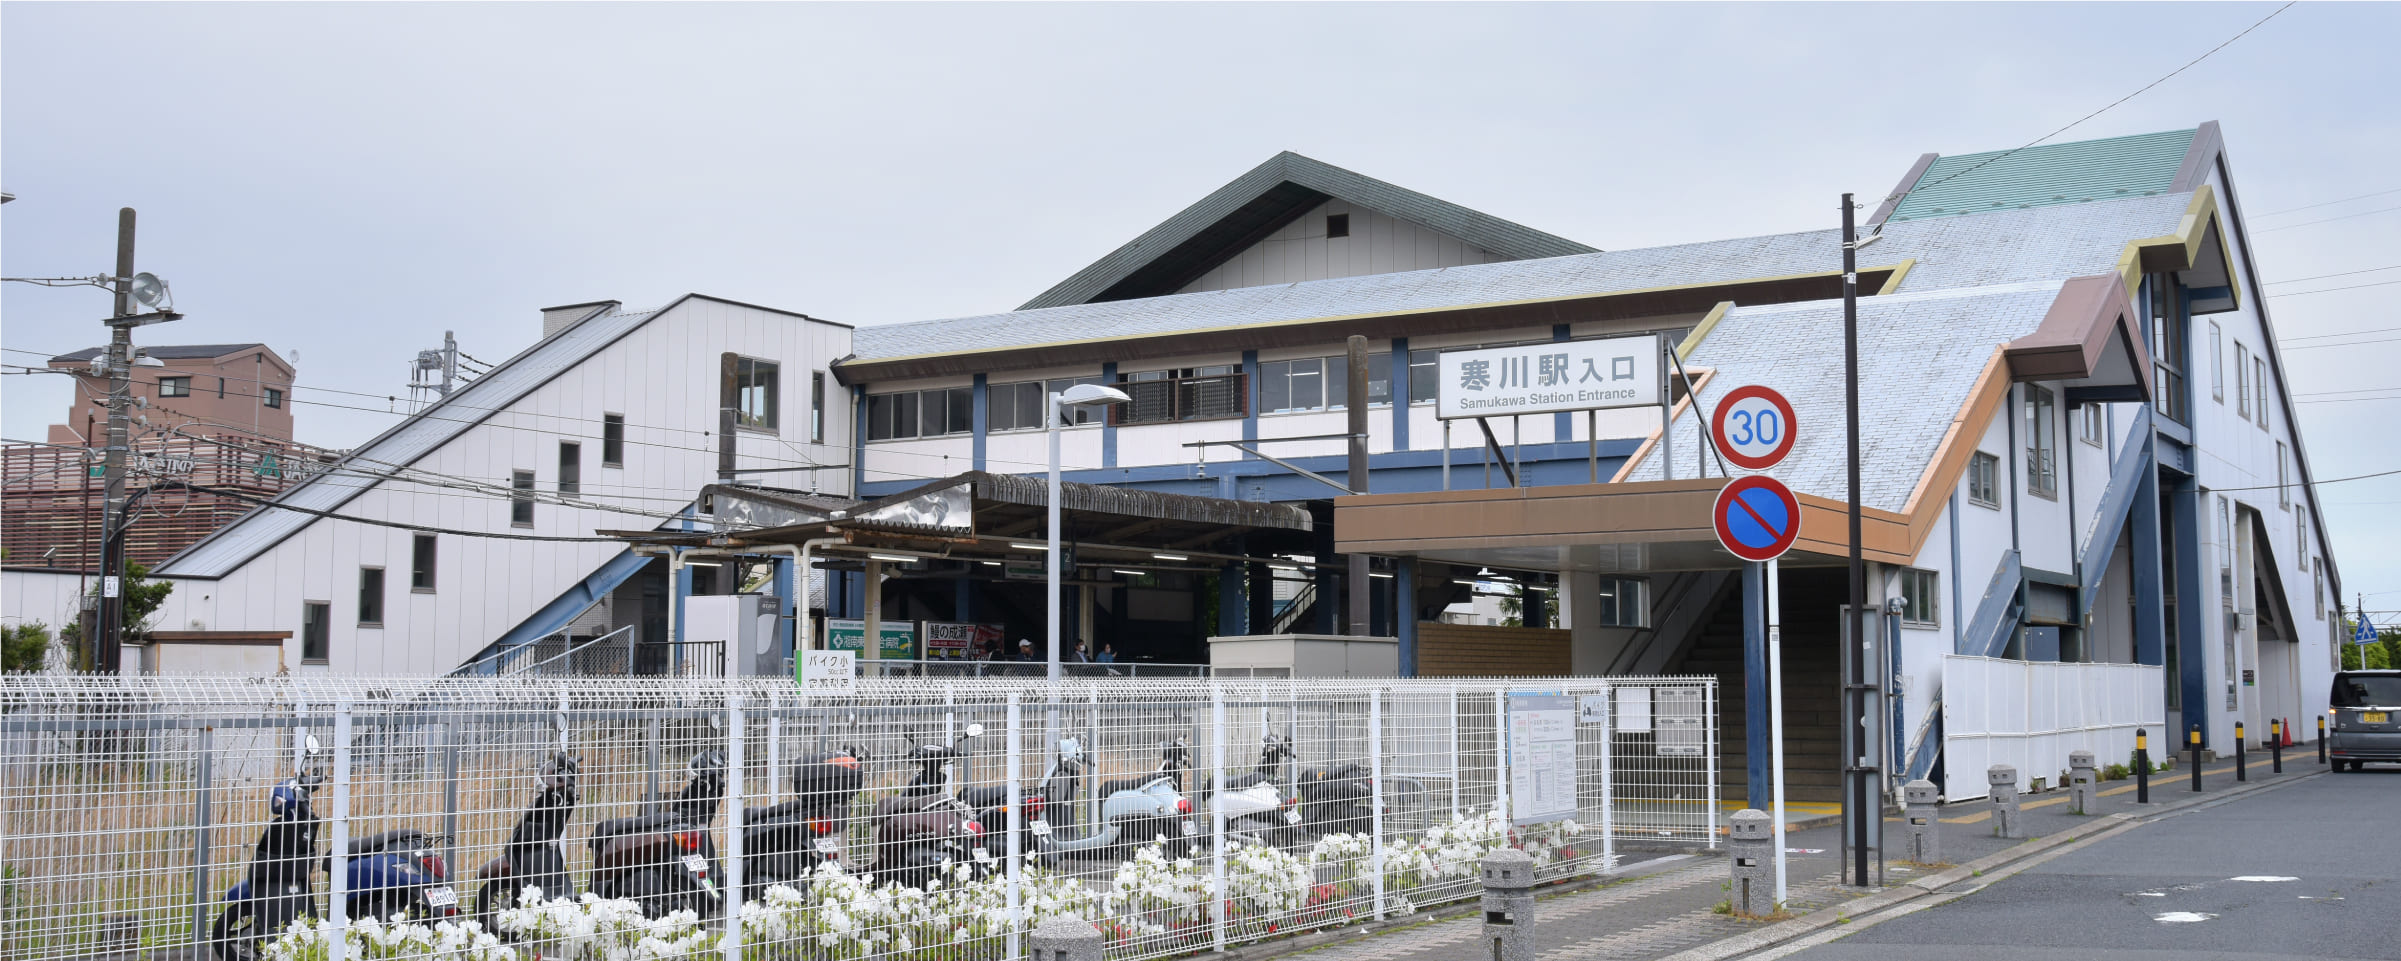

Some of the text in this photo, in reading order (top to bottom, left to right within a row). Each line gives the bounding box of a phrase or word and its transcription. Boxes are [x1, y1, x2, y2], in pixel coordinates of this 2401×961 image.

[1460, 353, 1635, 391] 寒川駅入口
[1460, 388, 1636, 410] Samukawa Station Entrance
[1732, 409, 1778, 446] 30
